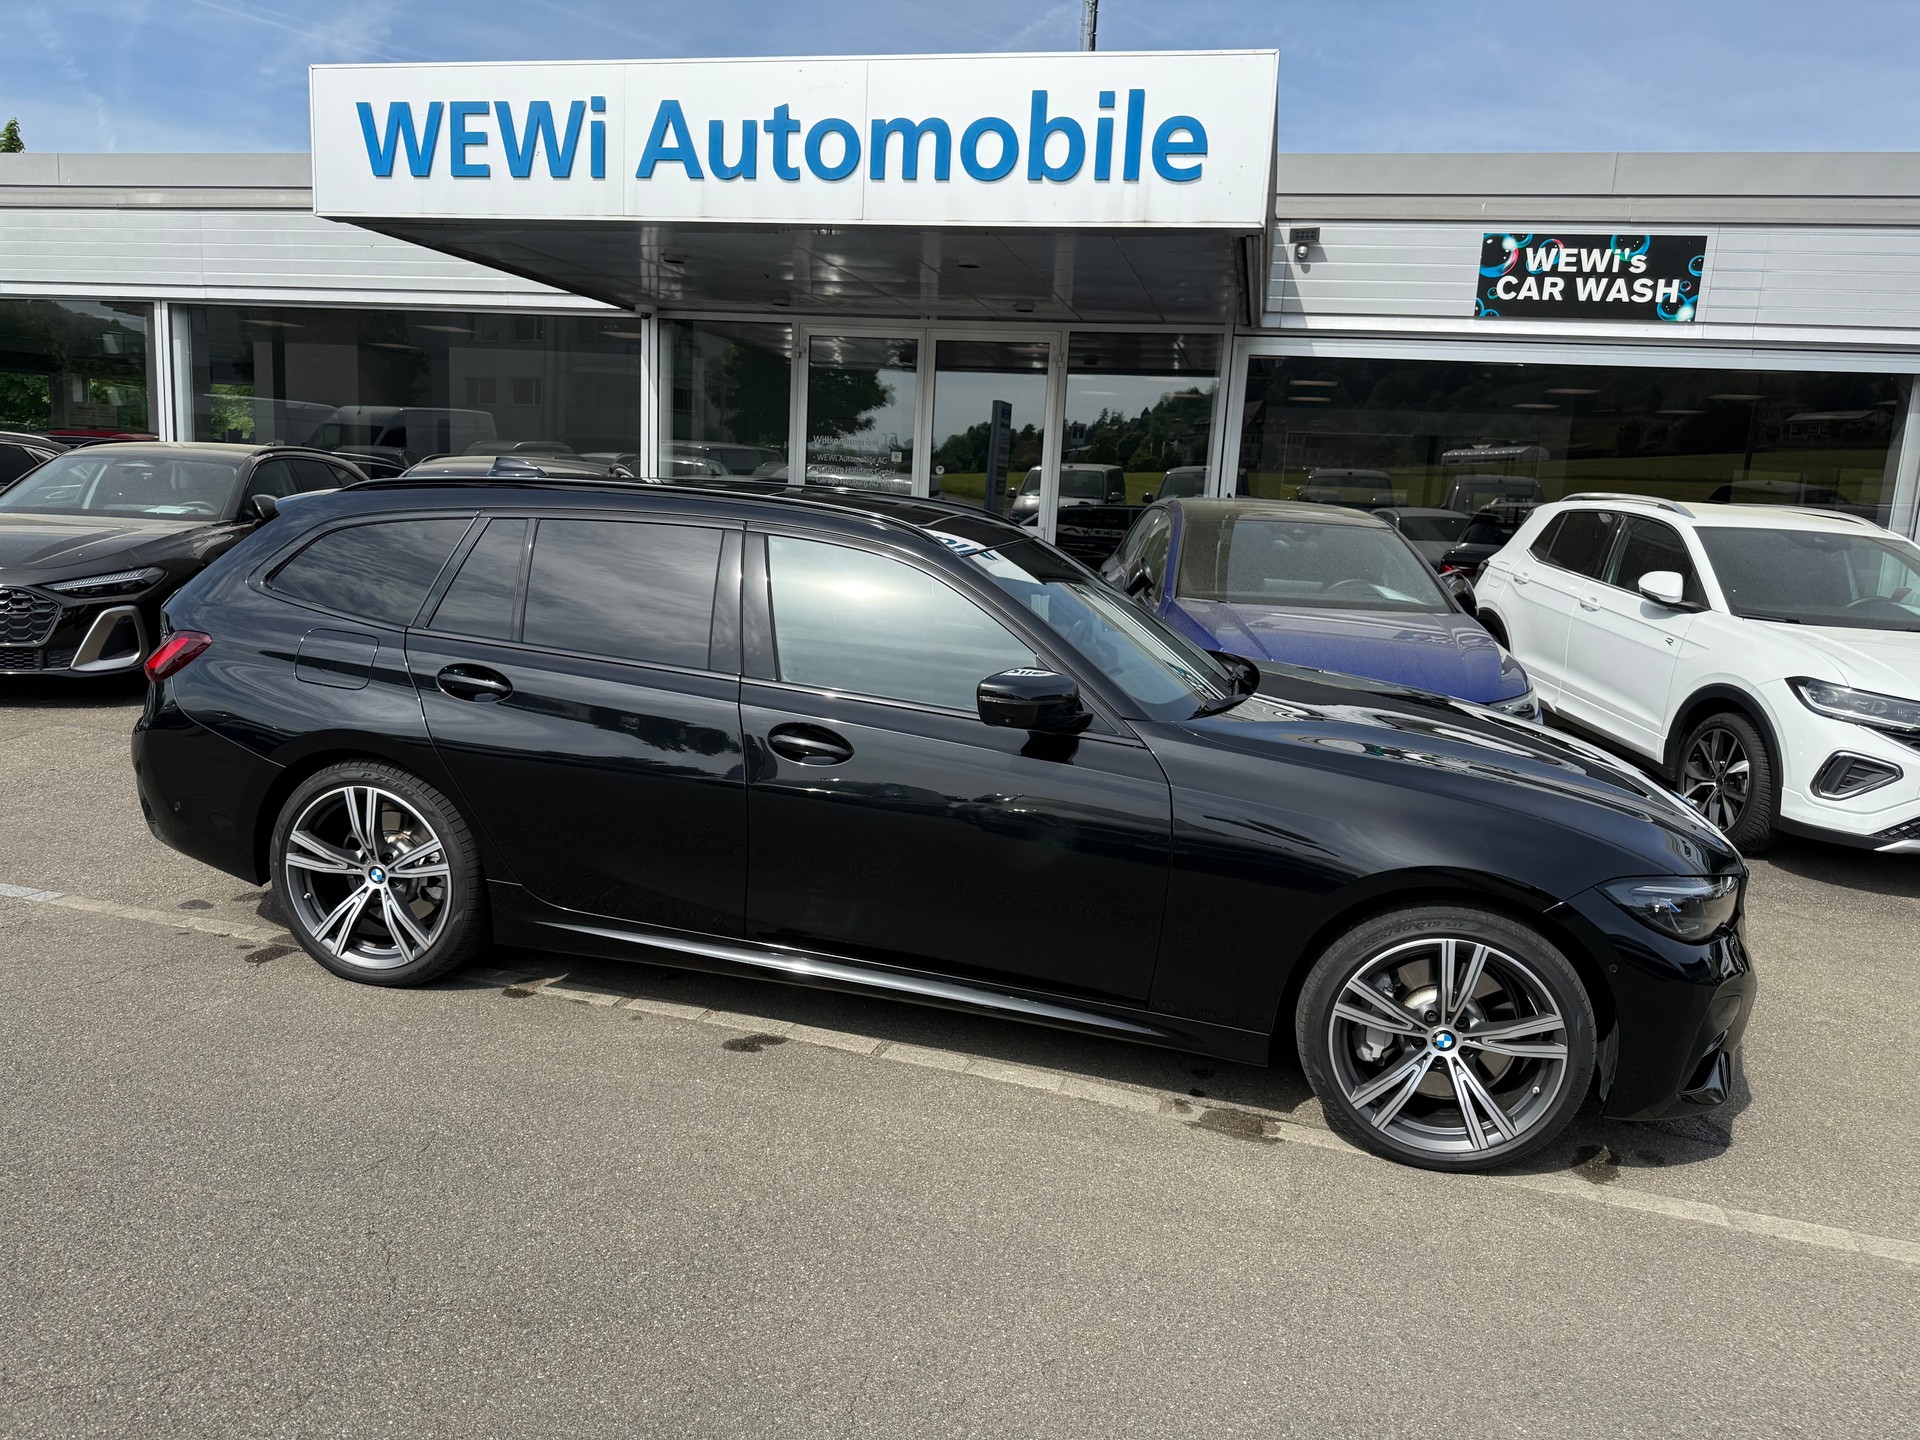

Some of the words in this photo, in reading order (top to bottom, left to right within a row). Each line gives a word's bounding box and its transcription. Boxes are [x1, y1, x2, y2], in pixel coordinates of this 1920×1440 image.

[356, 96, 605, 179] WEWi
[636, 88, 1208, 183] Automobile
[1526, 247, 1647, 274] WEWi's
[1496, 276, 1565, 301] CAR
[1575, 278, 1680, 304] WASH
[817, 453, 838, 462] WEWi
[839, 455, 876, 464] Automobile
[878, 457, 888, 465] AG
[845, 466, 875, 477] Holidays
